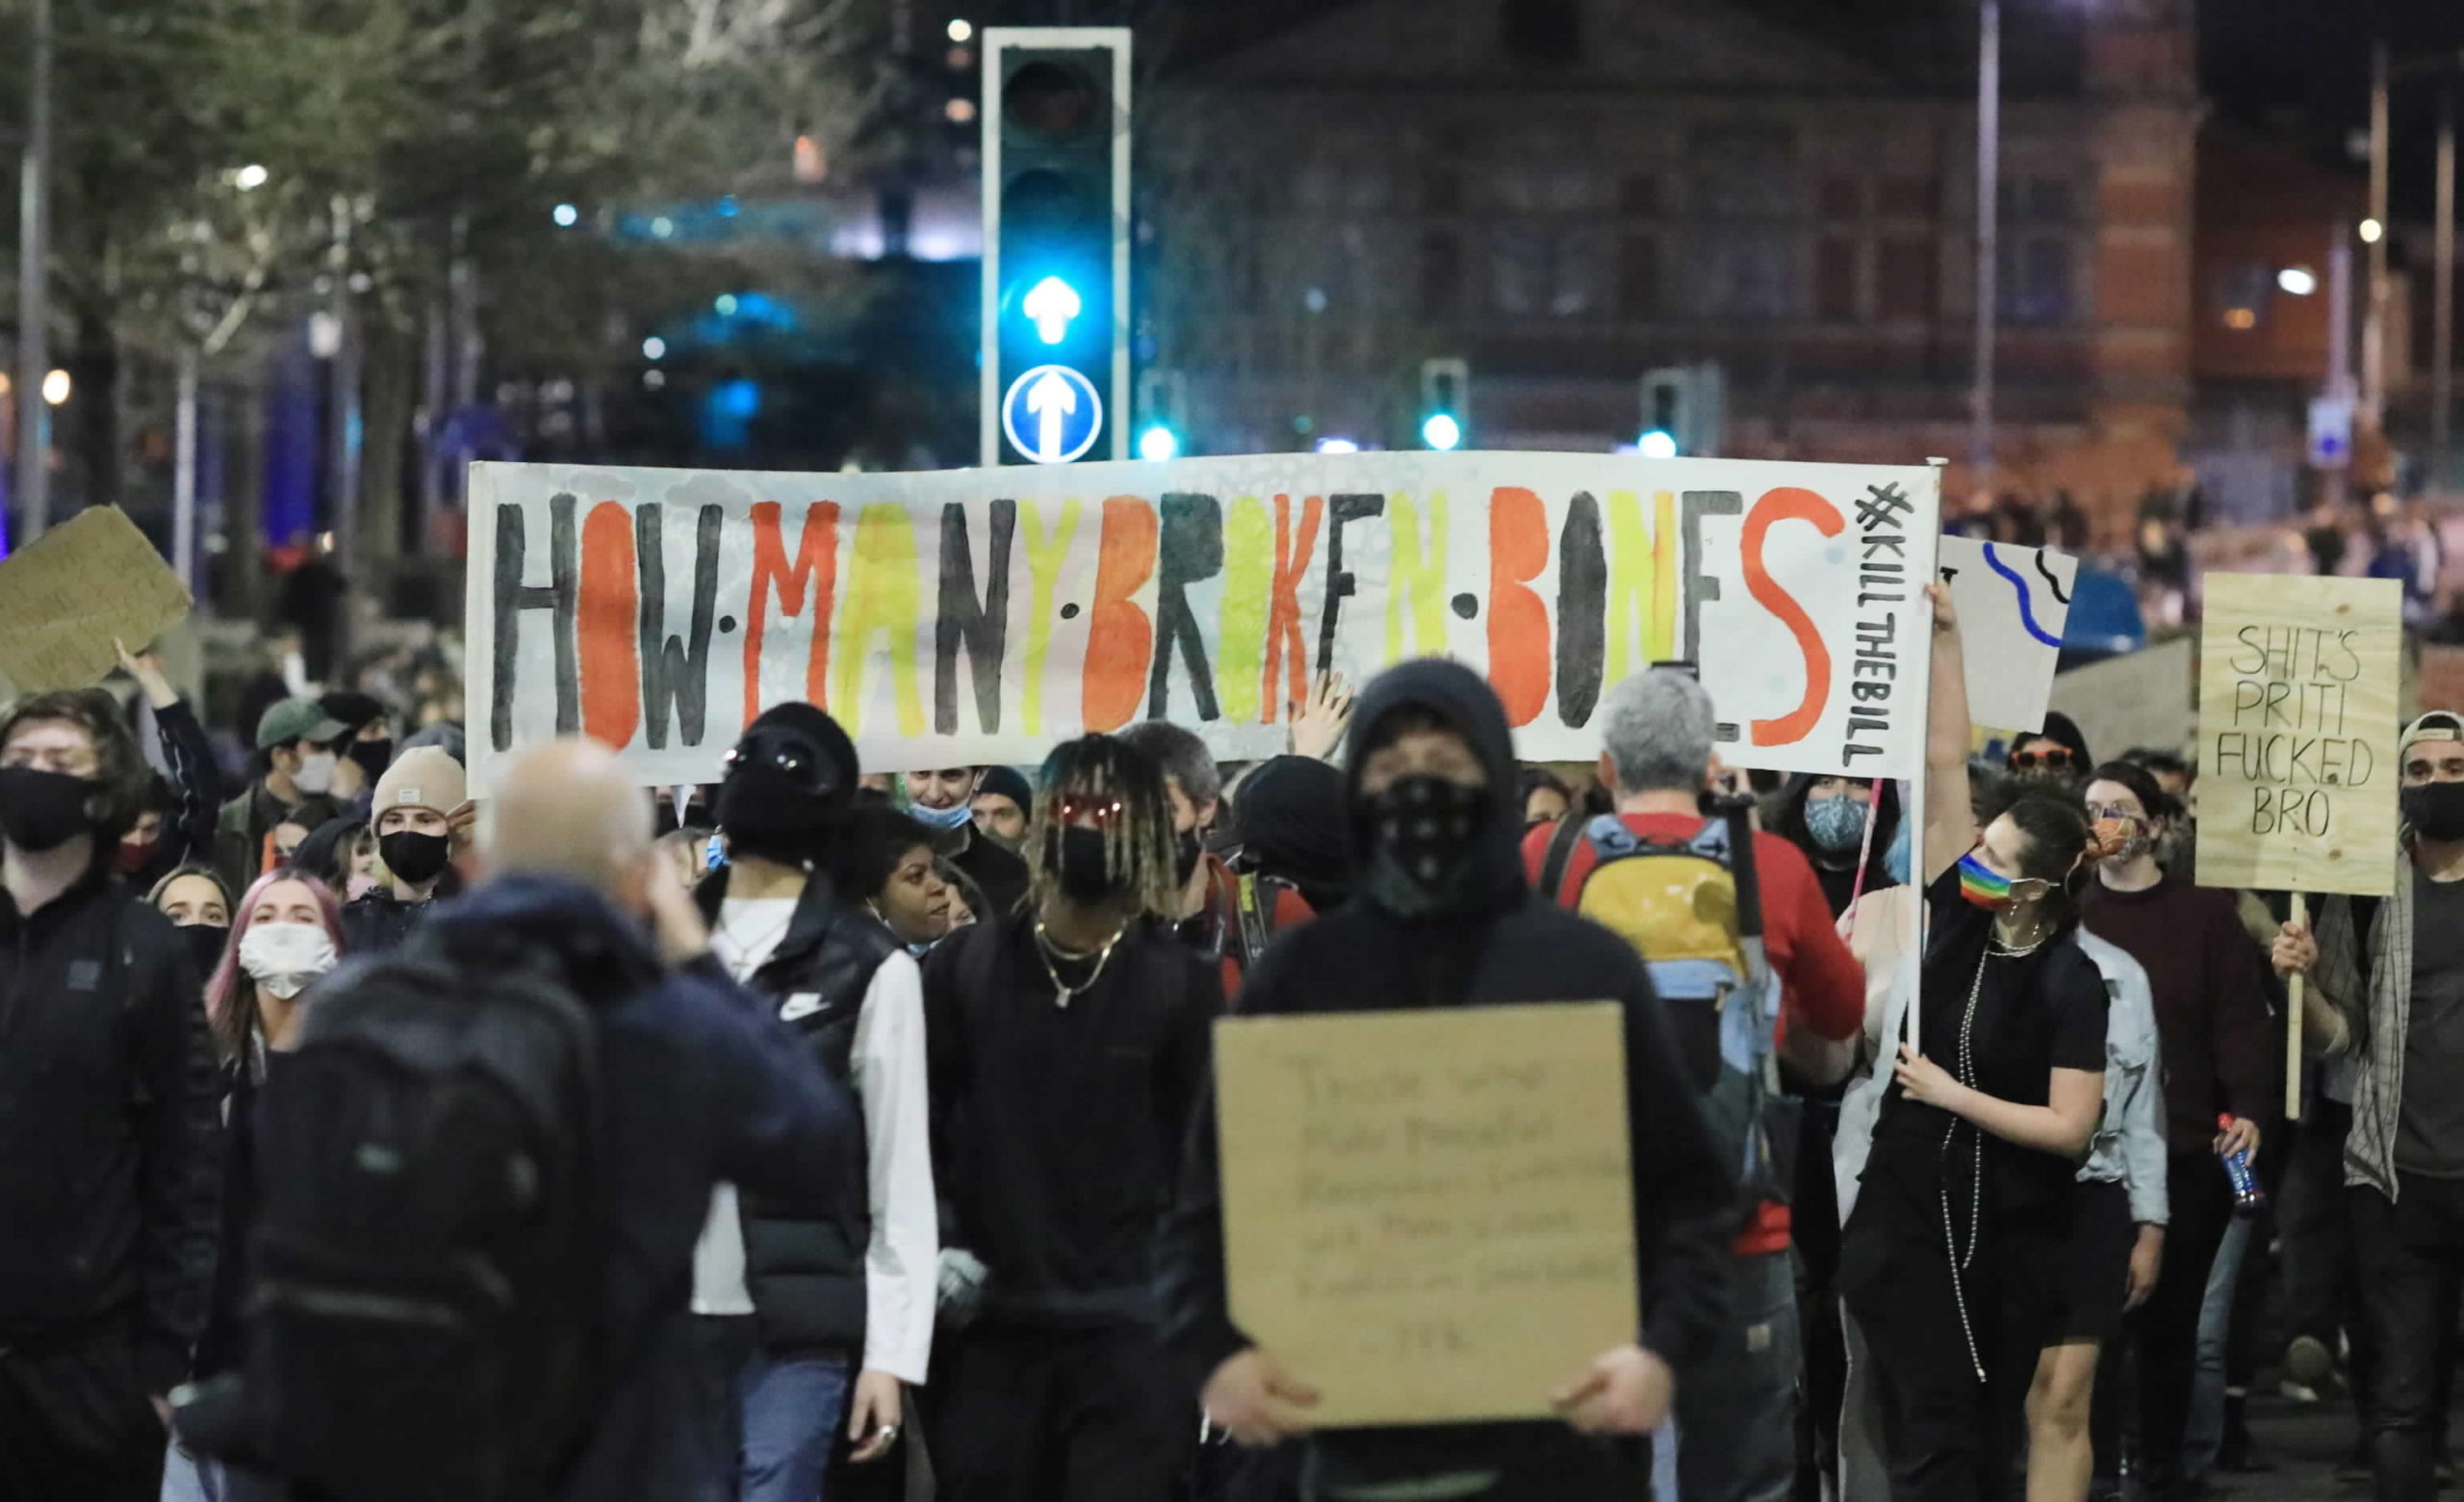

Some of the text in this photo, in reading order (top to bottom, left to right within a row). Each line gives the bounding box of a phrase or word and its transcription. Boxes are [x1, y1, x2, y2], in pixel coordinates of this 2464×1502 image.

[491, 492, 724, 751] HOW
[742, 498, 1083, 738] MANY
[1486, 485, 1845, 748] BONES
[2233, 679, 2347, 736] PRITI
[2217, 732, 2374, 787] FUCKED
[2251, 786, 2330, 838] BRO
